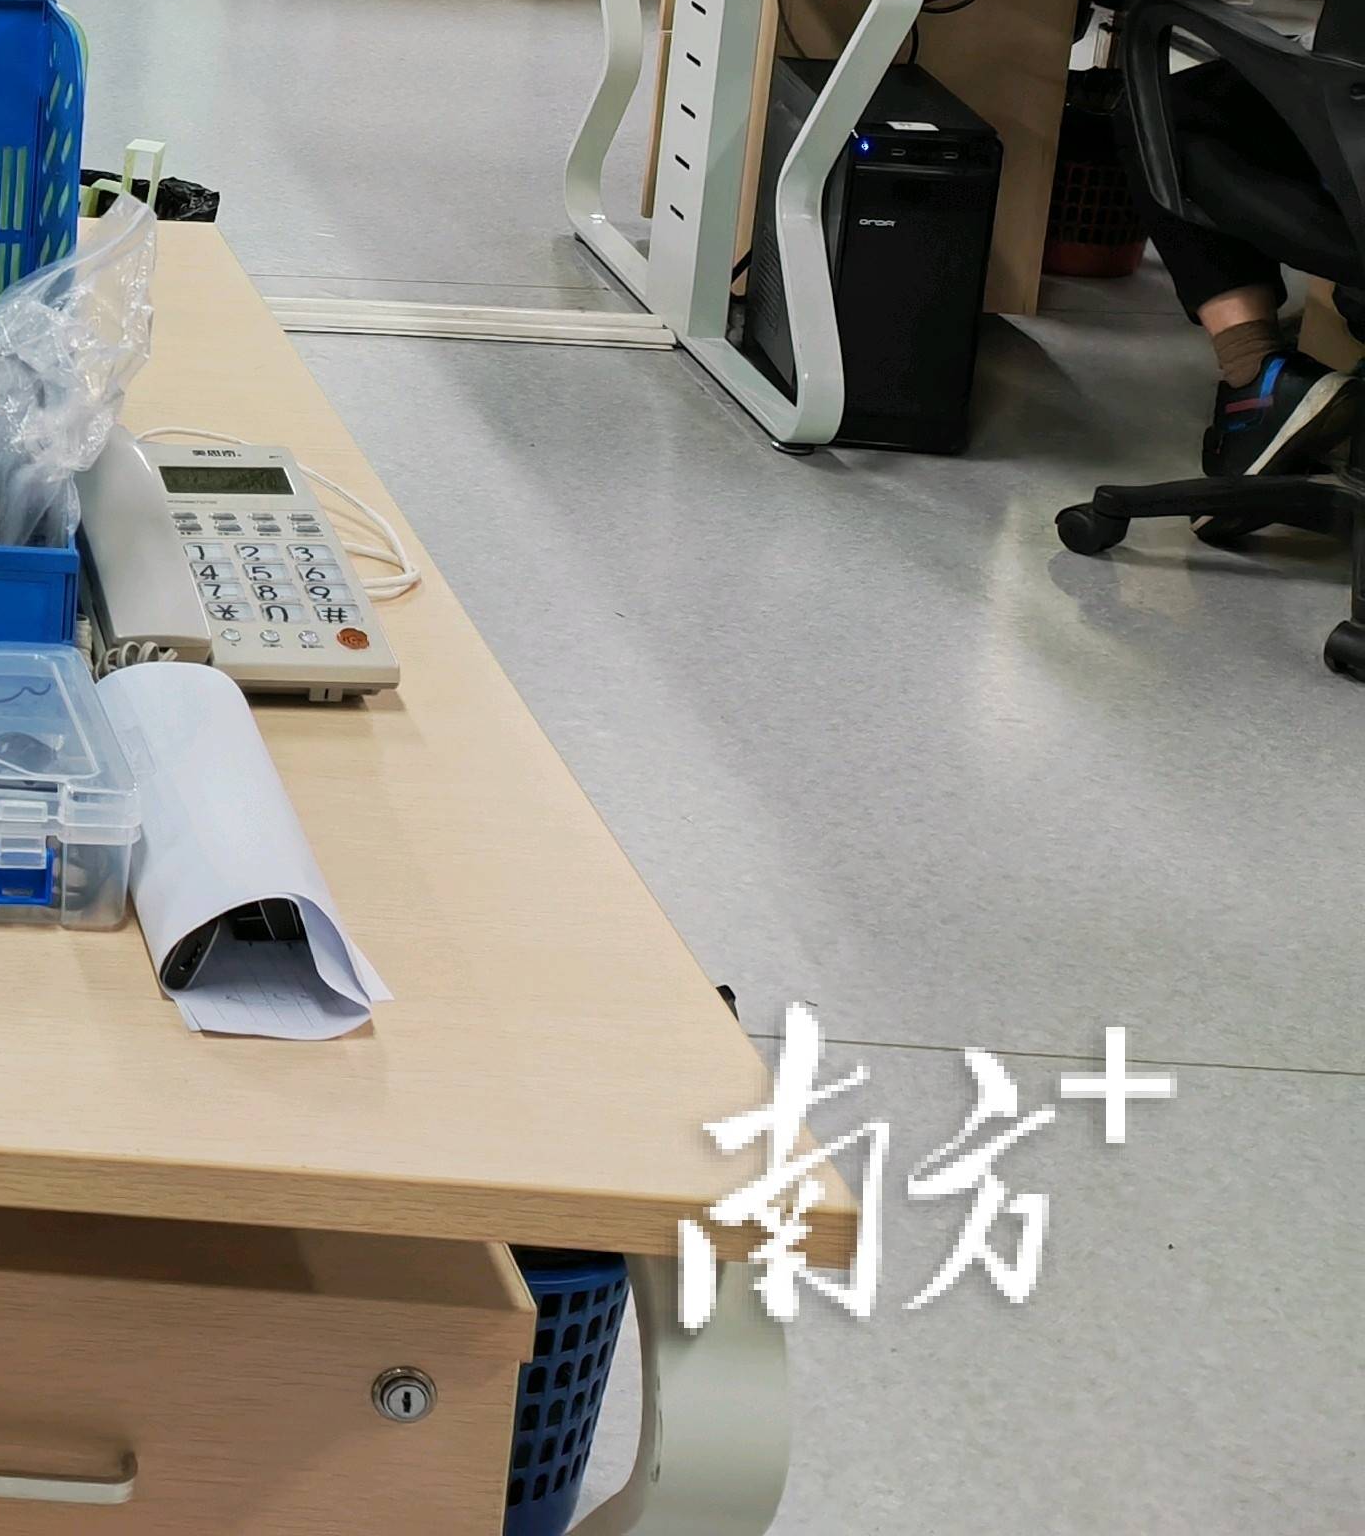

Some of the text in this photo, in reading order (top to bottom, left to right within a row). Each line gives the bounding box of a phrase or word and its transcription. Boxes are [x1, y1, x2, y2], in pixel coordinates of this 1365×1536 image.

[199, 564, 219, 581] 4
[250, 566, 272, 580] 5
[258, 585, 278, 600] 8
